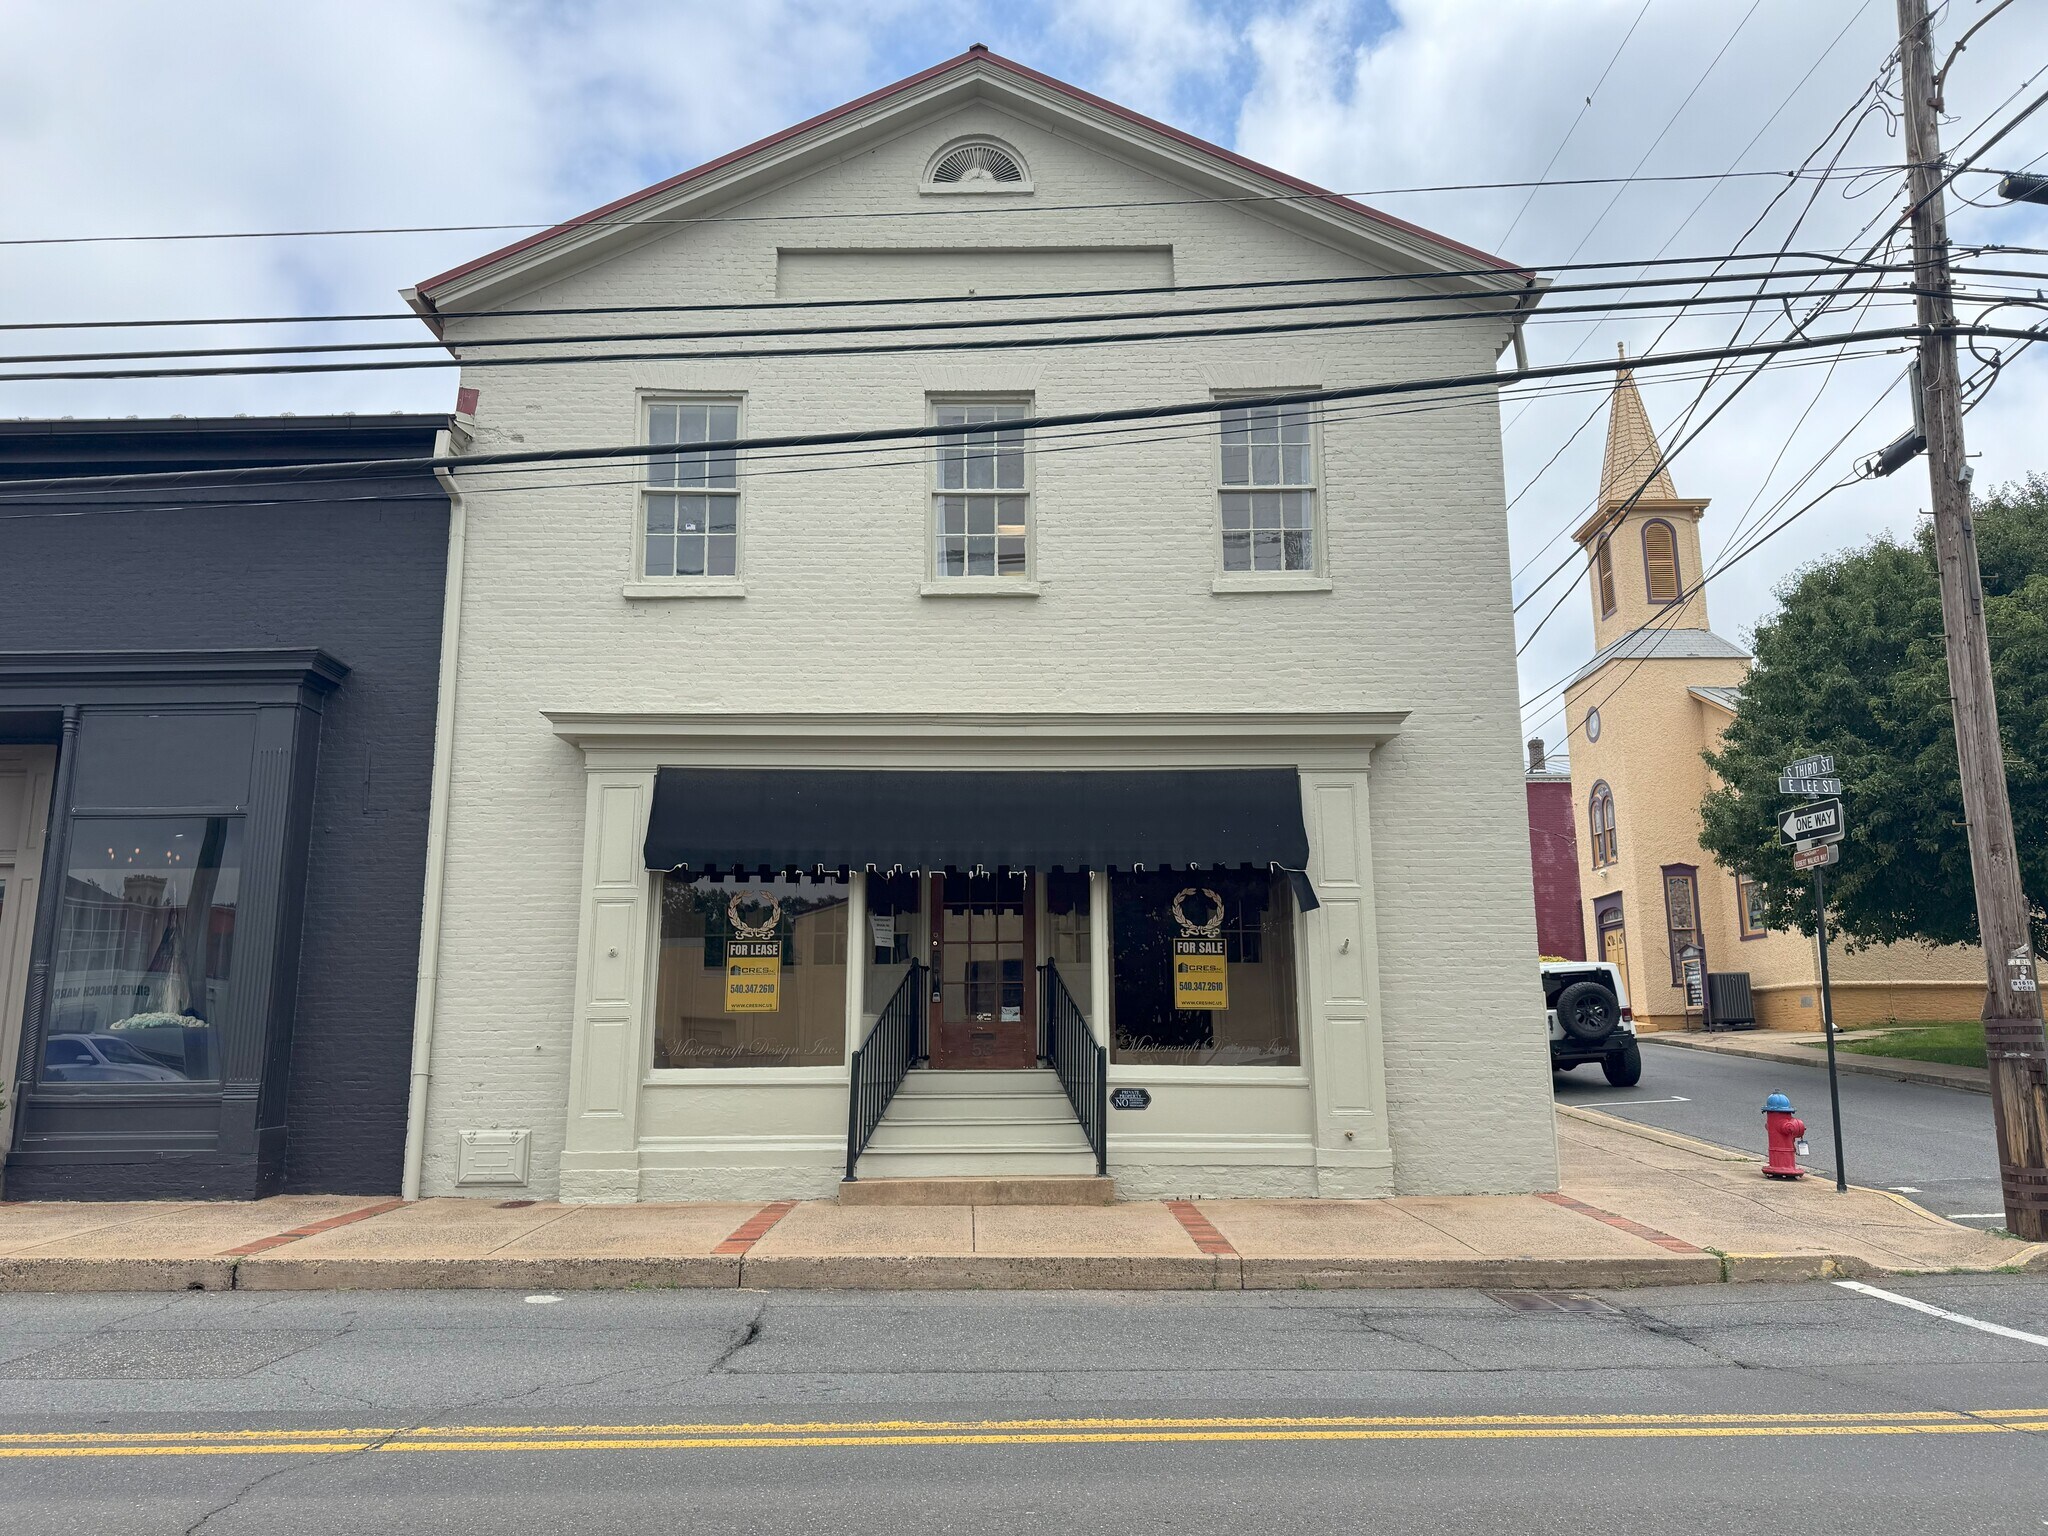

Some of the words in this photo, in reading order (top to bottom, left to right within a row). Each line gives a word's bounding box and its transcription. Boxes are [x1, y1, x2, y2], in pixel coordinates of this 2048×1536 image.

[1795, 762, 1817, 778] THIRD
[1789, 780, 1797, 791] E.
[1801, 780, 1818, 792] LEE
[1823, 780, 1836, 792] ST.
[1796, 816, 1813, 831] ONE
[1815, 811, 1832, 827] WAY
[730, 944, 748, 955] FOR
[750, 944, 778, 955] LEASE
[1177, 942, 1196, 953] FOR
[1199, 942, 1223, 953] SALE
[730, 984, 775, 994] 540.347.2610
[1179, 981, 1223, 991] 540.347.2610
[661, 1038, 744, 1062] Mastercraft
[748, 1038, 799, 1062] Design
[804, 1037, 838, 1055] Inc.
[1118, 1034, 1200, 1058] Mastercraft
[1114, 1098, 1129, 1107] NO
